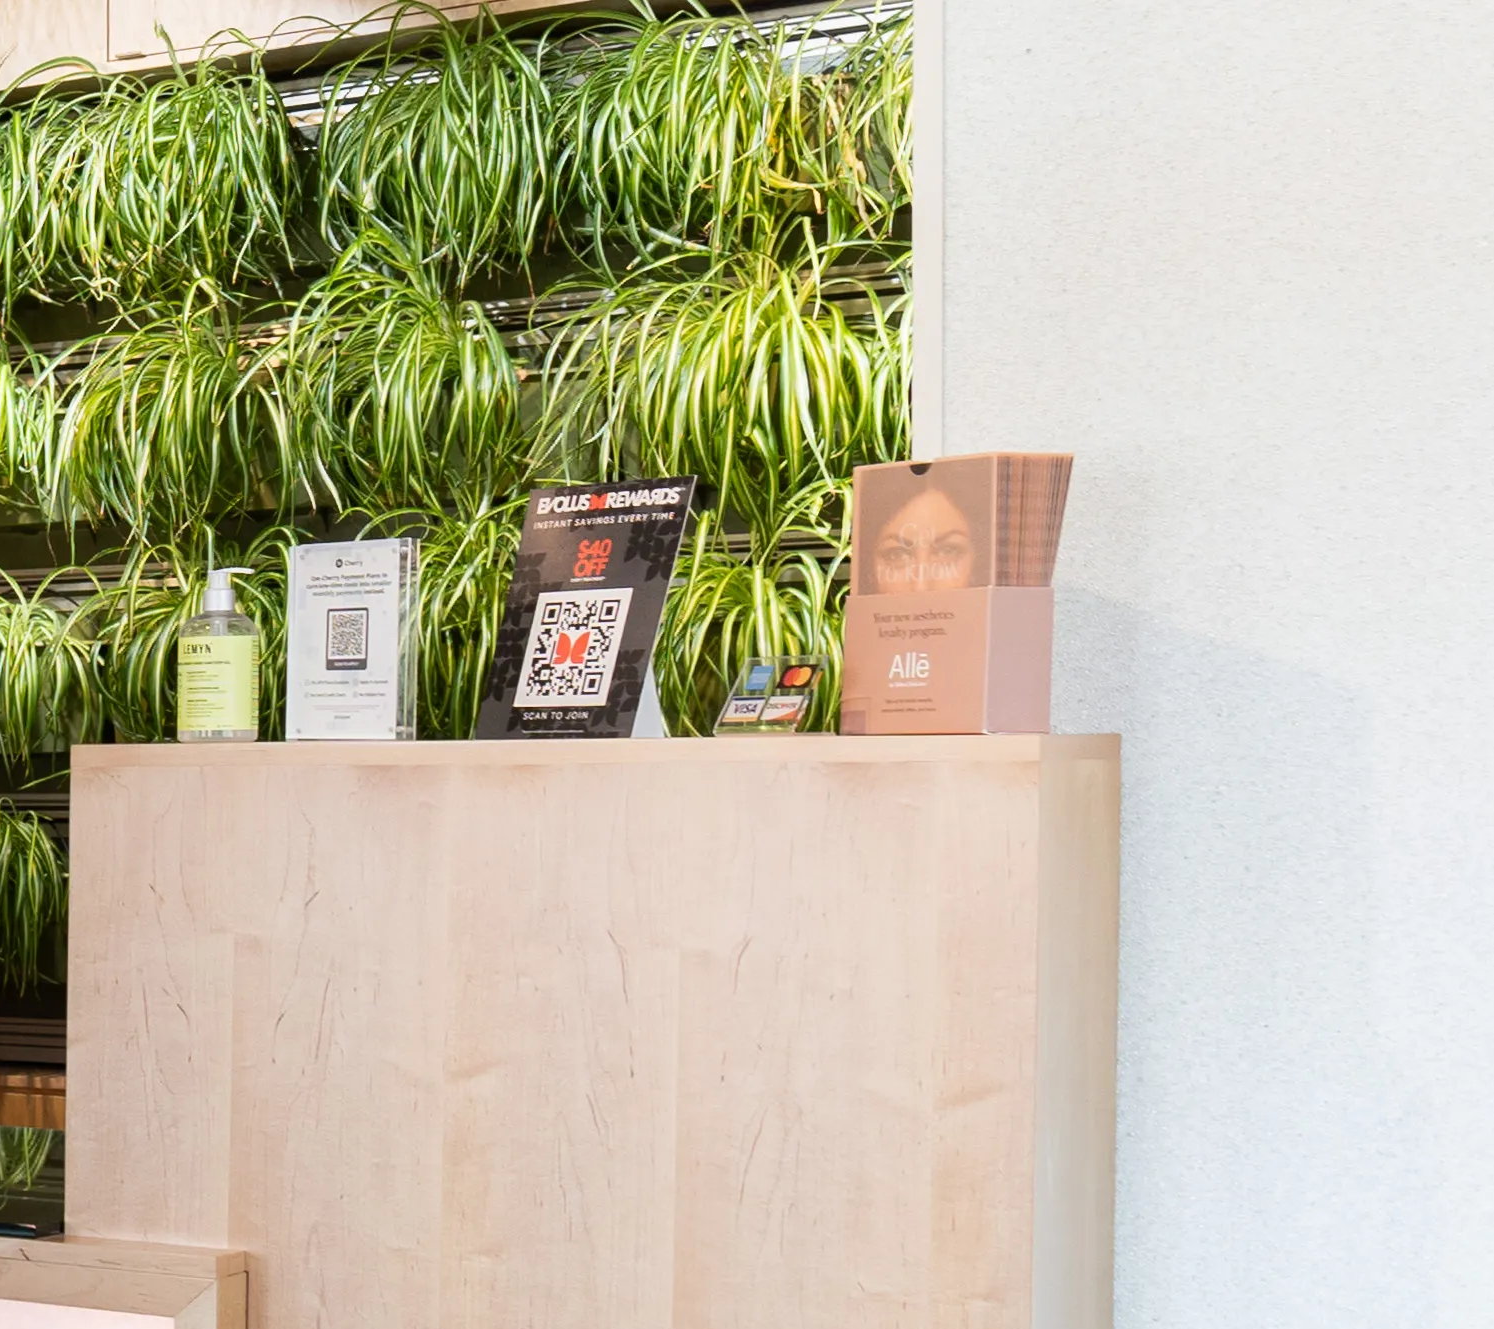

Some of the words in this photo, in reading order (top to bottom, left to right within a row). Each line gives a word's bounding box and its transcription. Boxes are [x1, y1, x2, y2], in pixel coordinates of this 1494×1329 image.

[537, 495, 590, 515] EVOLUS
[605, 487, 681, 508] REWARDS
[533, 519, 572, 530] INSTANT
[574, 516, 615, 527] SAVINGS
[618, 513, 649, 524] EVERY
[651, 511, 676, 521] TIME
[578, 538, 612, 556] $40
[573, 559, 609, 577] OFF
[873, 612, 893, 623] Your
[888, 652, 930, 680] Allē
[522, 711, 548, 721] SCAN
[551, 711, 563, 721] TO
[565, 711, 589, 720] JOIN
